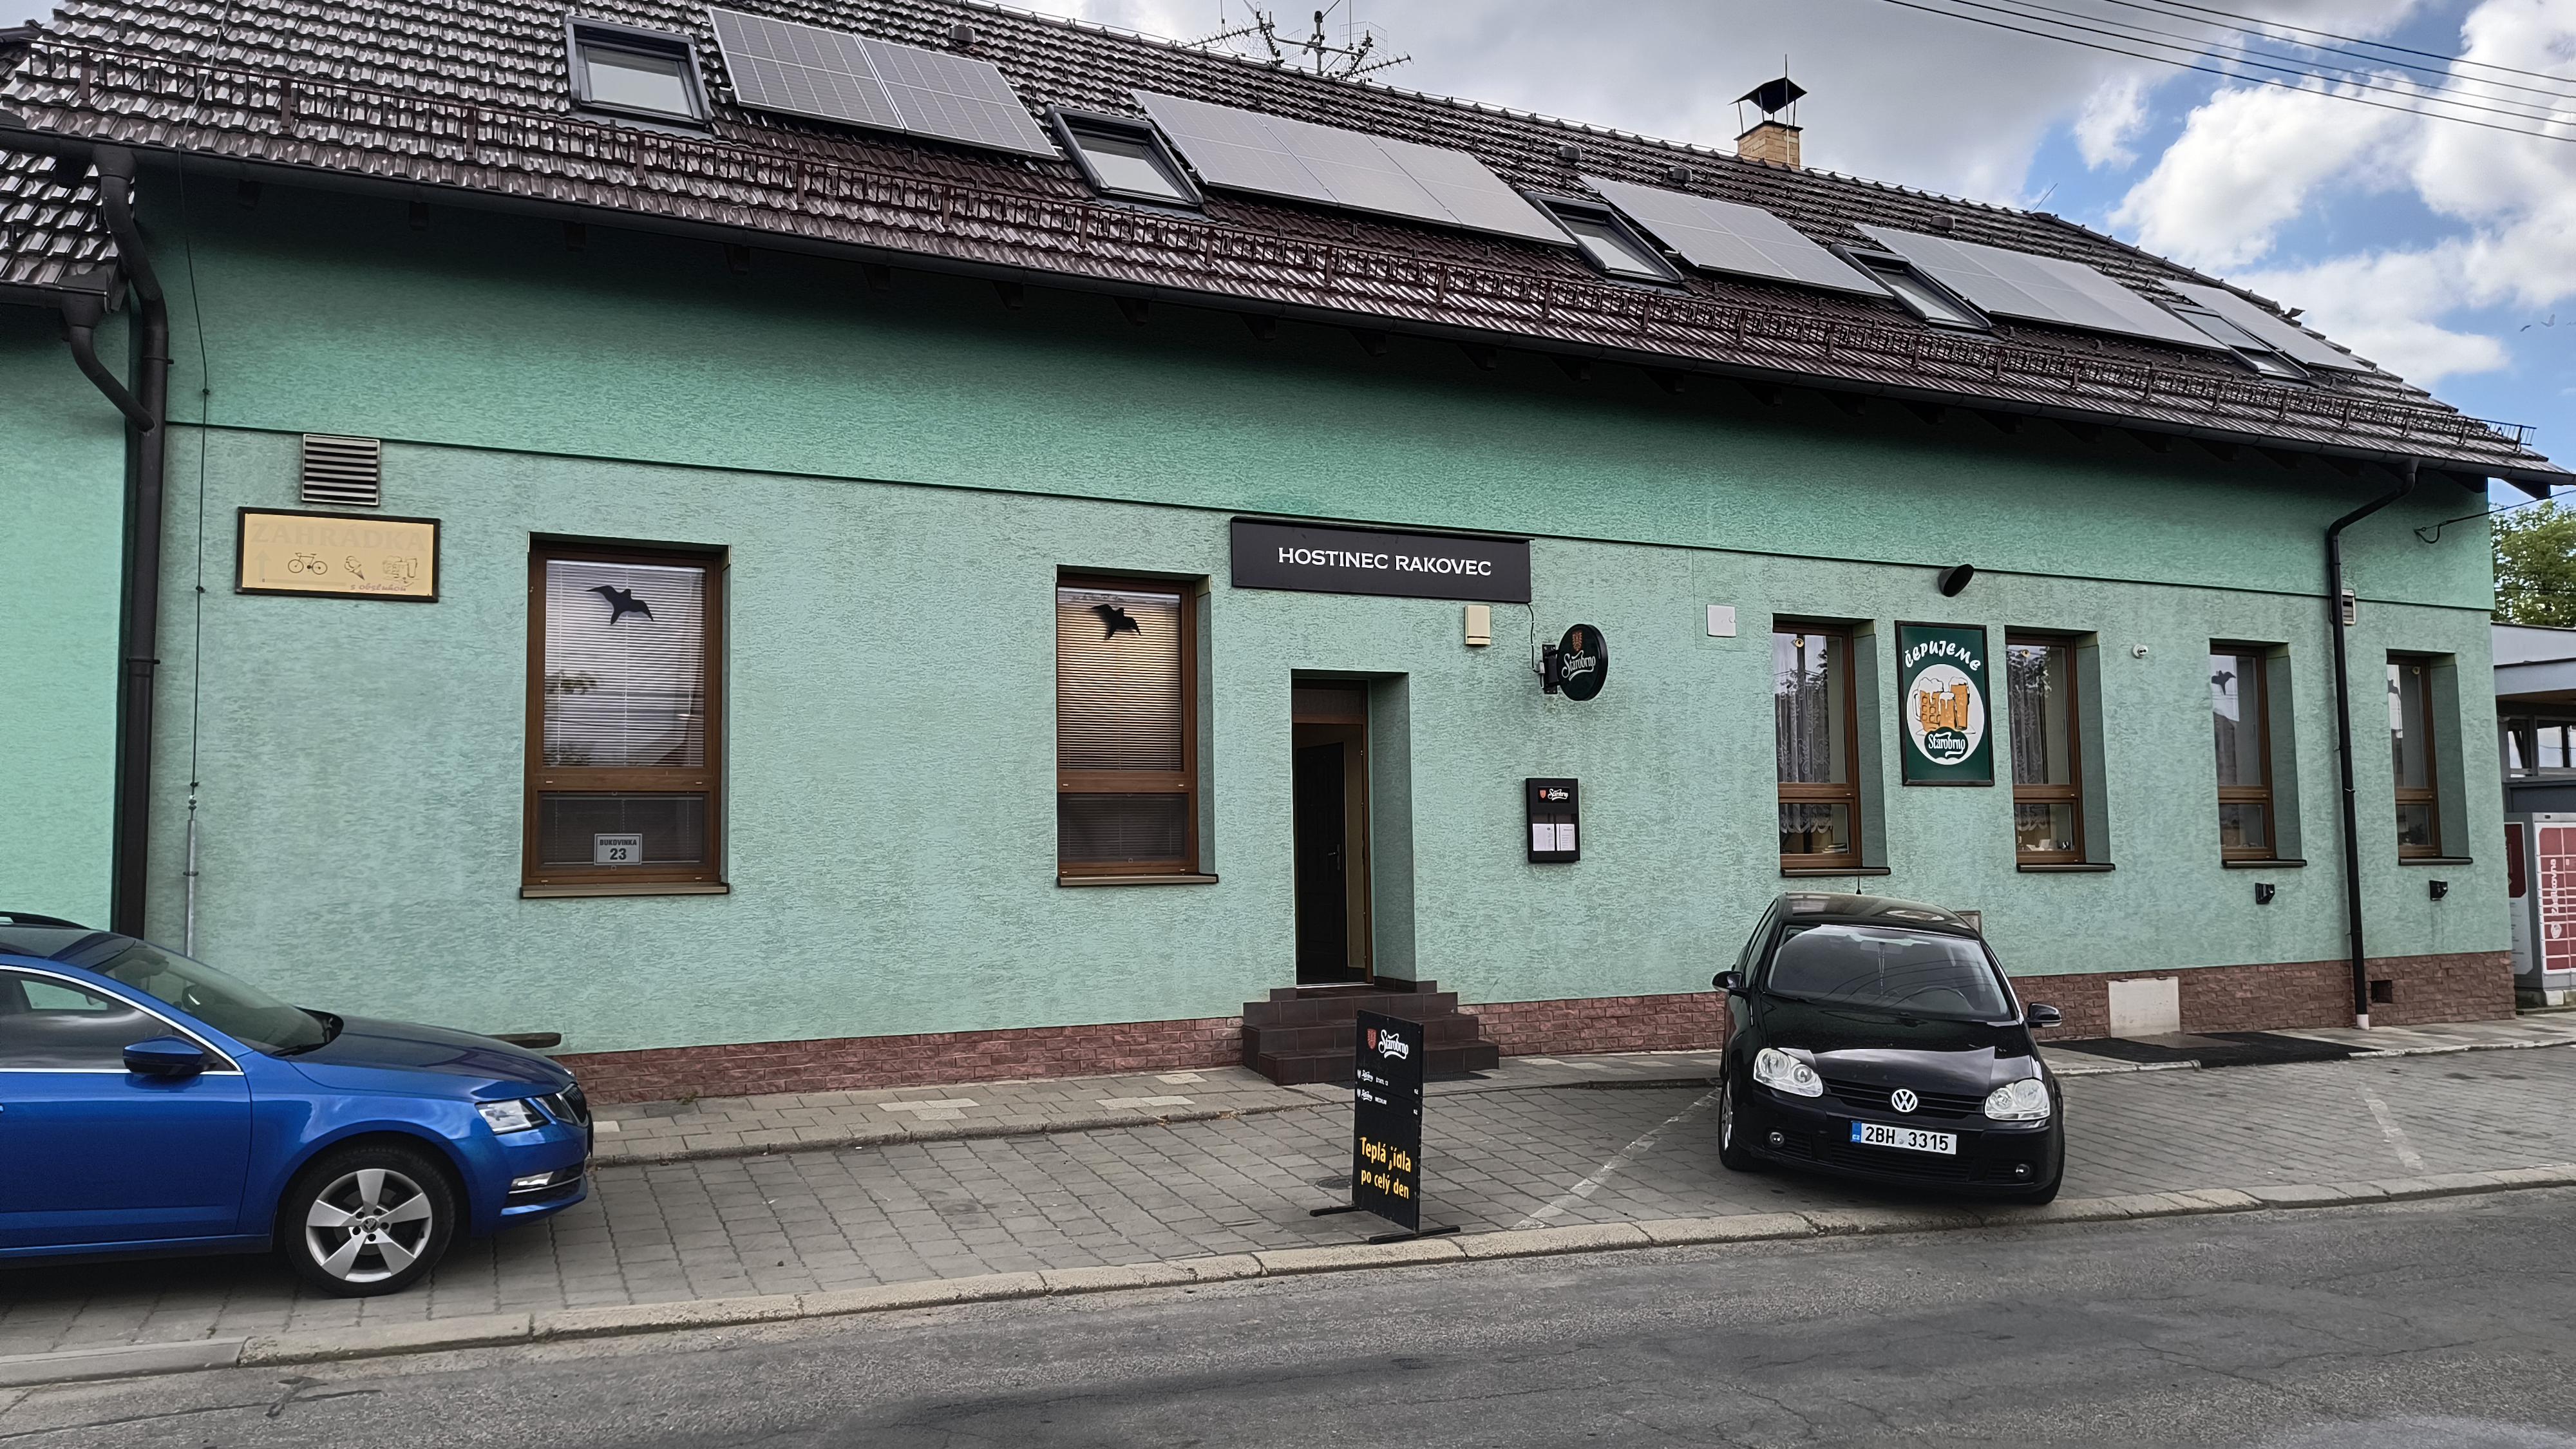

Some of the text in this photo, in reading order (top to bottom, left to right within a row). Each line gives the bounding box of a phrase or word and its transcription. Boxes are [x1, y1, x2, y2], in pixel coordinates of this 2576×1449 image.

[250, 522, 427, 552] ZAHRÁDKA
[1278, 547, 1492, 576] HOSTINEC RAKOVEC
[1561, 650, 1596, 681] Starobrno
[1905, 641, 1982, 671] ČEPUJEME
[1928, 732, 1966, 757] Starobrno
[609, 848, 627, 860] 23
[1378, 1029, 1409, 1060] Starobrno
[1359, 1137, 1386, 1164] Teplá
[1865, 1126, 1896, 1144] 2BH
[1908, 1132, 1949, 1151] 3315
[1361, 1170, 1409, 1199] po celý den
